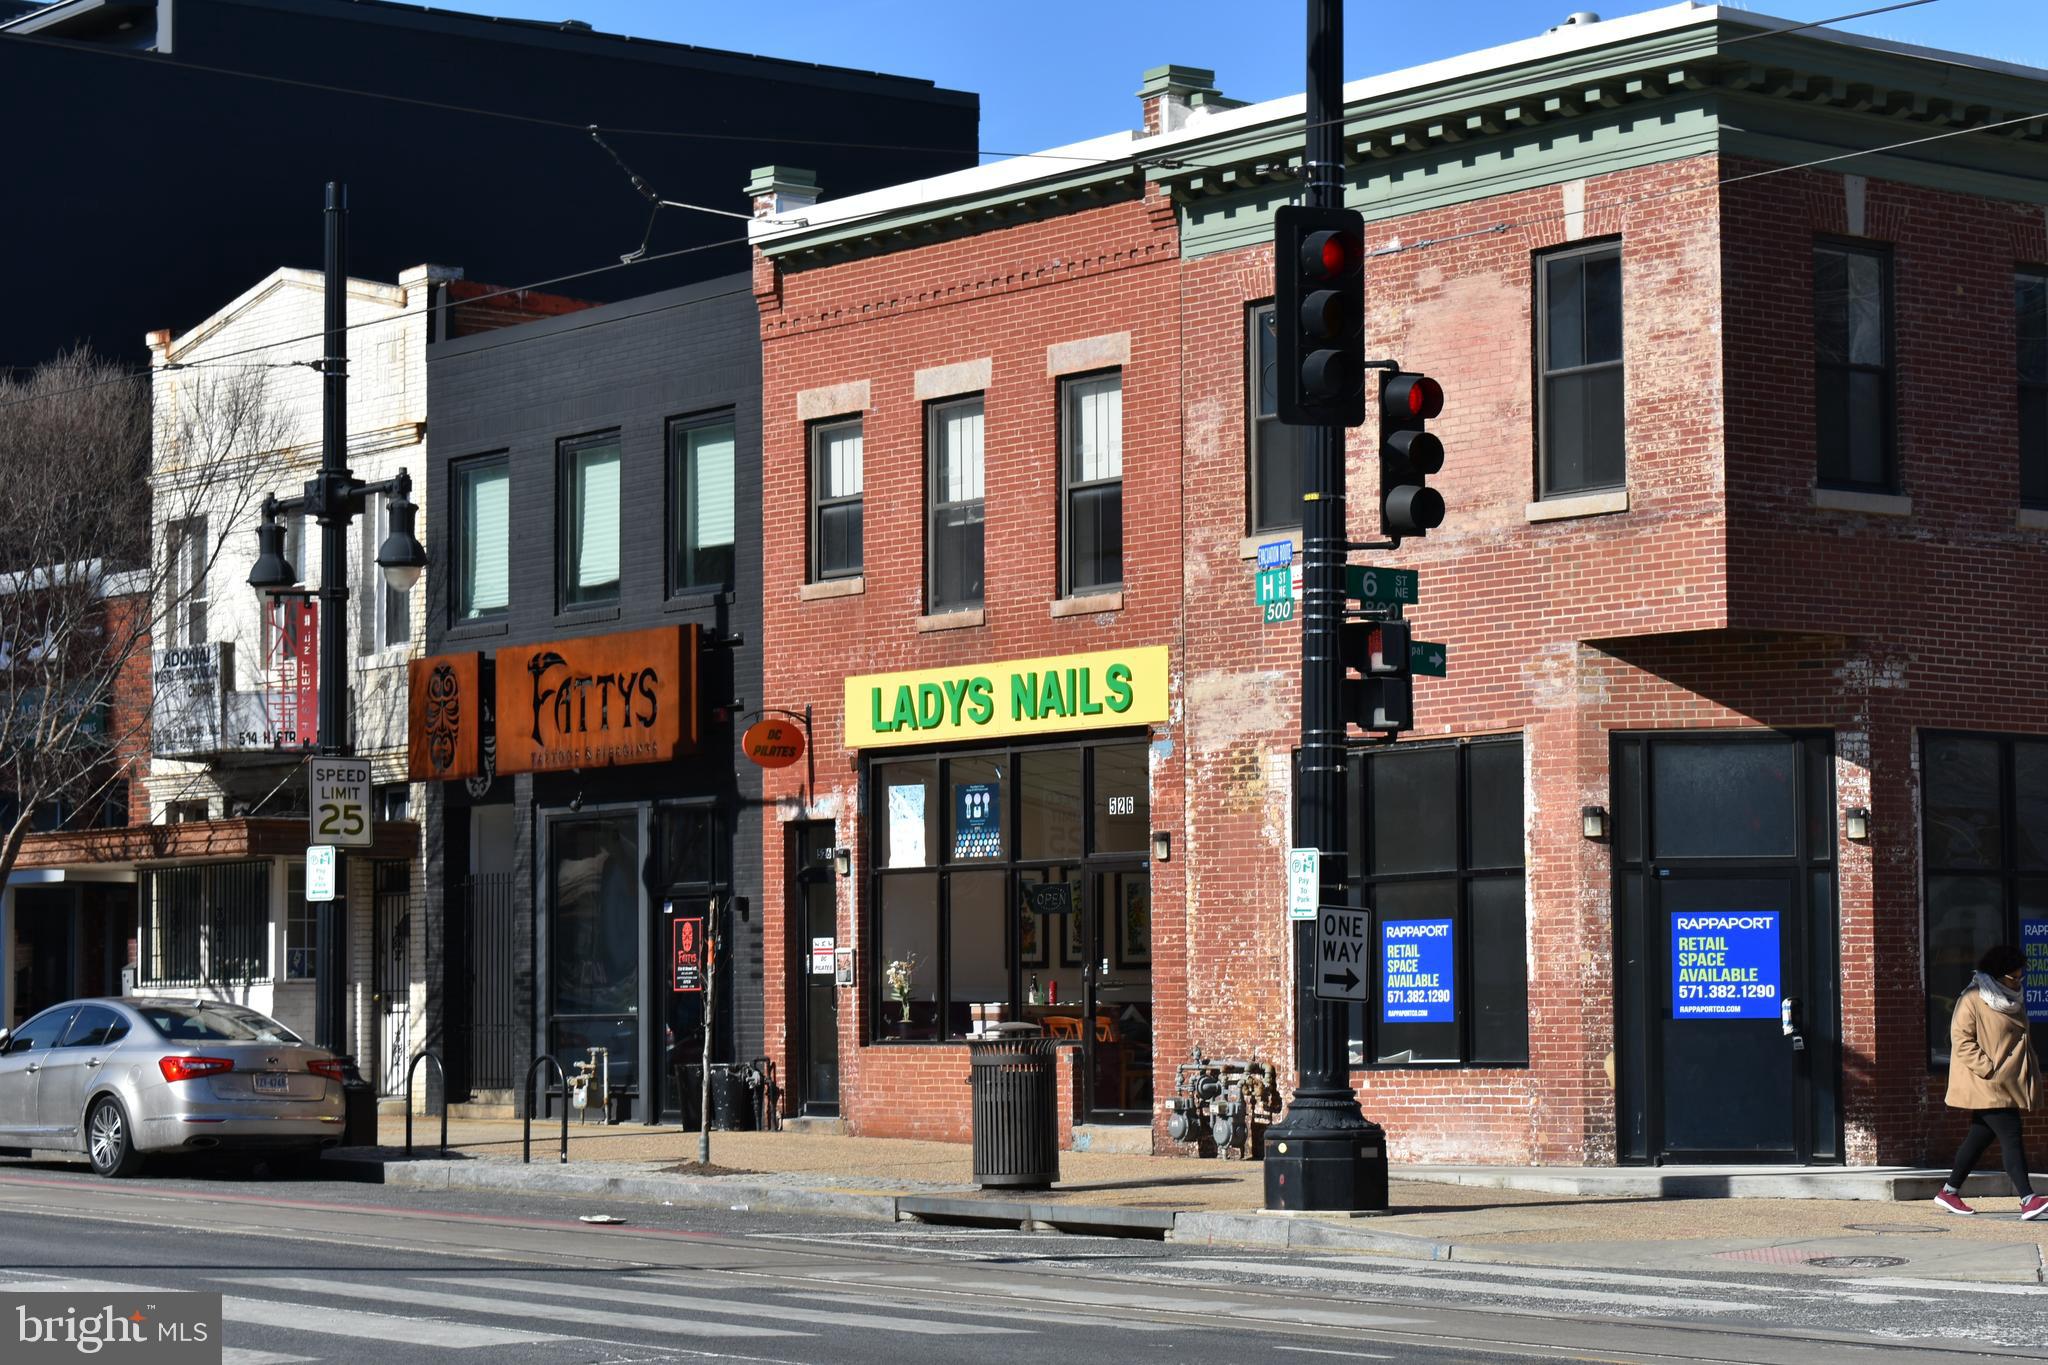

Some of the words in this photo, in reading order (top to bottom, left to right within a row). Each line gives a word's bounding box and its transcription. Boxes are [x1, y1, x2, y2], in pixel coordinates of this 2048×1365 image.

[1262, 574, 1274, 601] H
[1278, 571, 1287, 586] ST
[1362, 571, 1378, 597] 6
[1395, 575, 1408, 586] ST
[1278, 585, 1287, 599] NE
[1394, 587, 1409, 599] NE
[1267, 601, 1291, 621] 500
[1411, 645, 1424, 656] pal
[164, 649, 211, 668] ADONAI
[871, 676, 995, 733] LADYS
[1010, 663, 1134, 721] NAILS
[239, 731, 258, 745] 514
[263, 731, 271, 744] H
[767, 729, 782, 740] DC
[753, 745, 797, 757] PILATES
[316, 768, 367, 782] SPEED
[321, 786, 361, 800] LIMIT
[1109, 797, 1134, 815] 526
[319, 804, 364, 835] 25
[816, 847, 835, 860] 526
[1298, 877, 1310, 885] Pay
[1037, 893, 1066, 906] OPEN
[1324, 914, 1363, 938] ONE
[1677, 917, 1774, 930] RAPPAPORT
[1386, 925, 1449, 938] RAPPAPORT
[1387, 944, 1420, 958] RETAIL
[1679, 937, 1728, 951] RETAIL
[1323, 940, 1364, 964] WAY
[1679, 952, 1726, 966] SPACE
[1387, 959, 1418, 973] SPACE
[1387, 974, 1440, 988] AVAILABLE
[1679, 968, 1758, 982] AVAILABLE
[1387, 989, 1450, 1003] 571.382.1290
[1679, 984, 1775, 998] 571.382.1290
[1680, 1005, 1741, 1013] RAPPAPORTCO.COM
